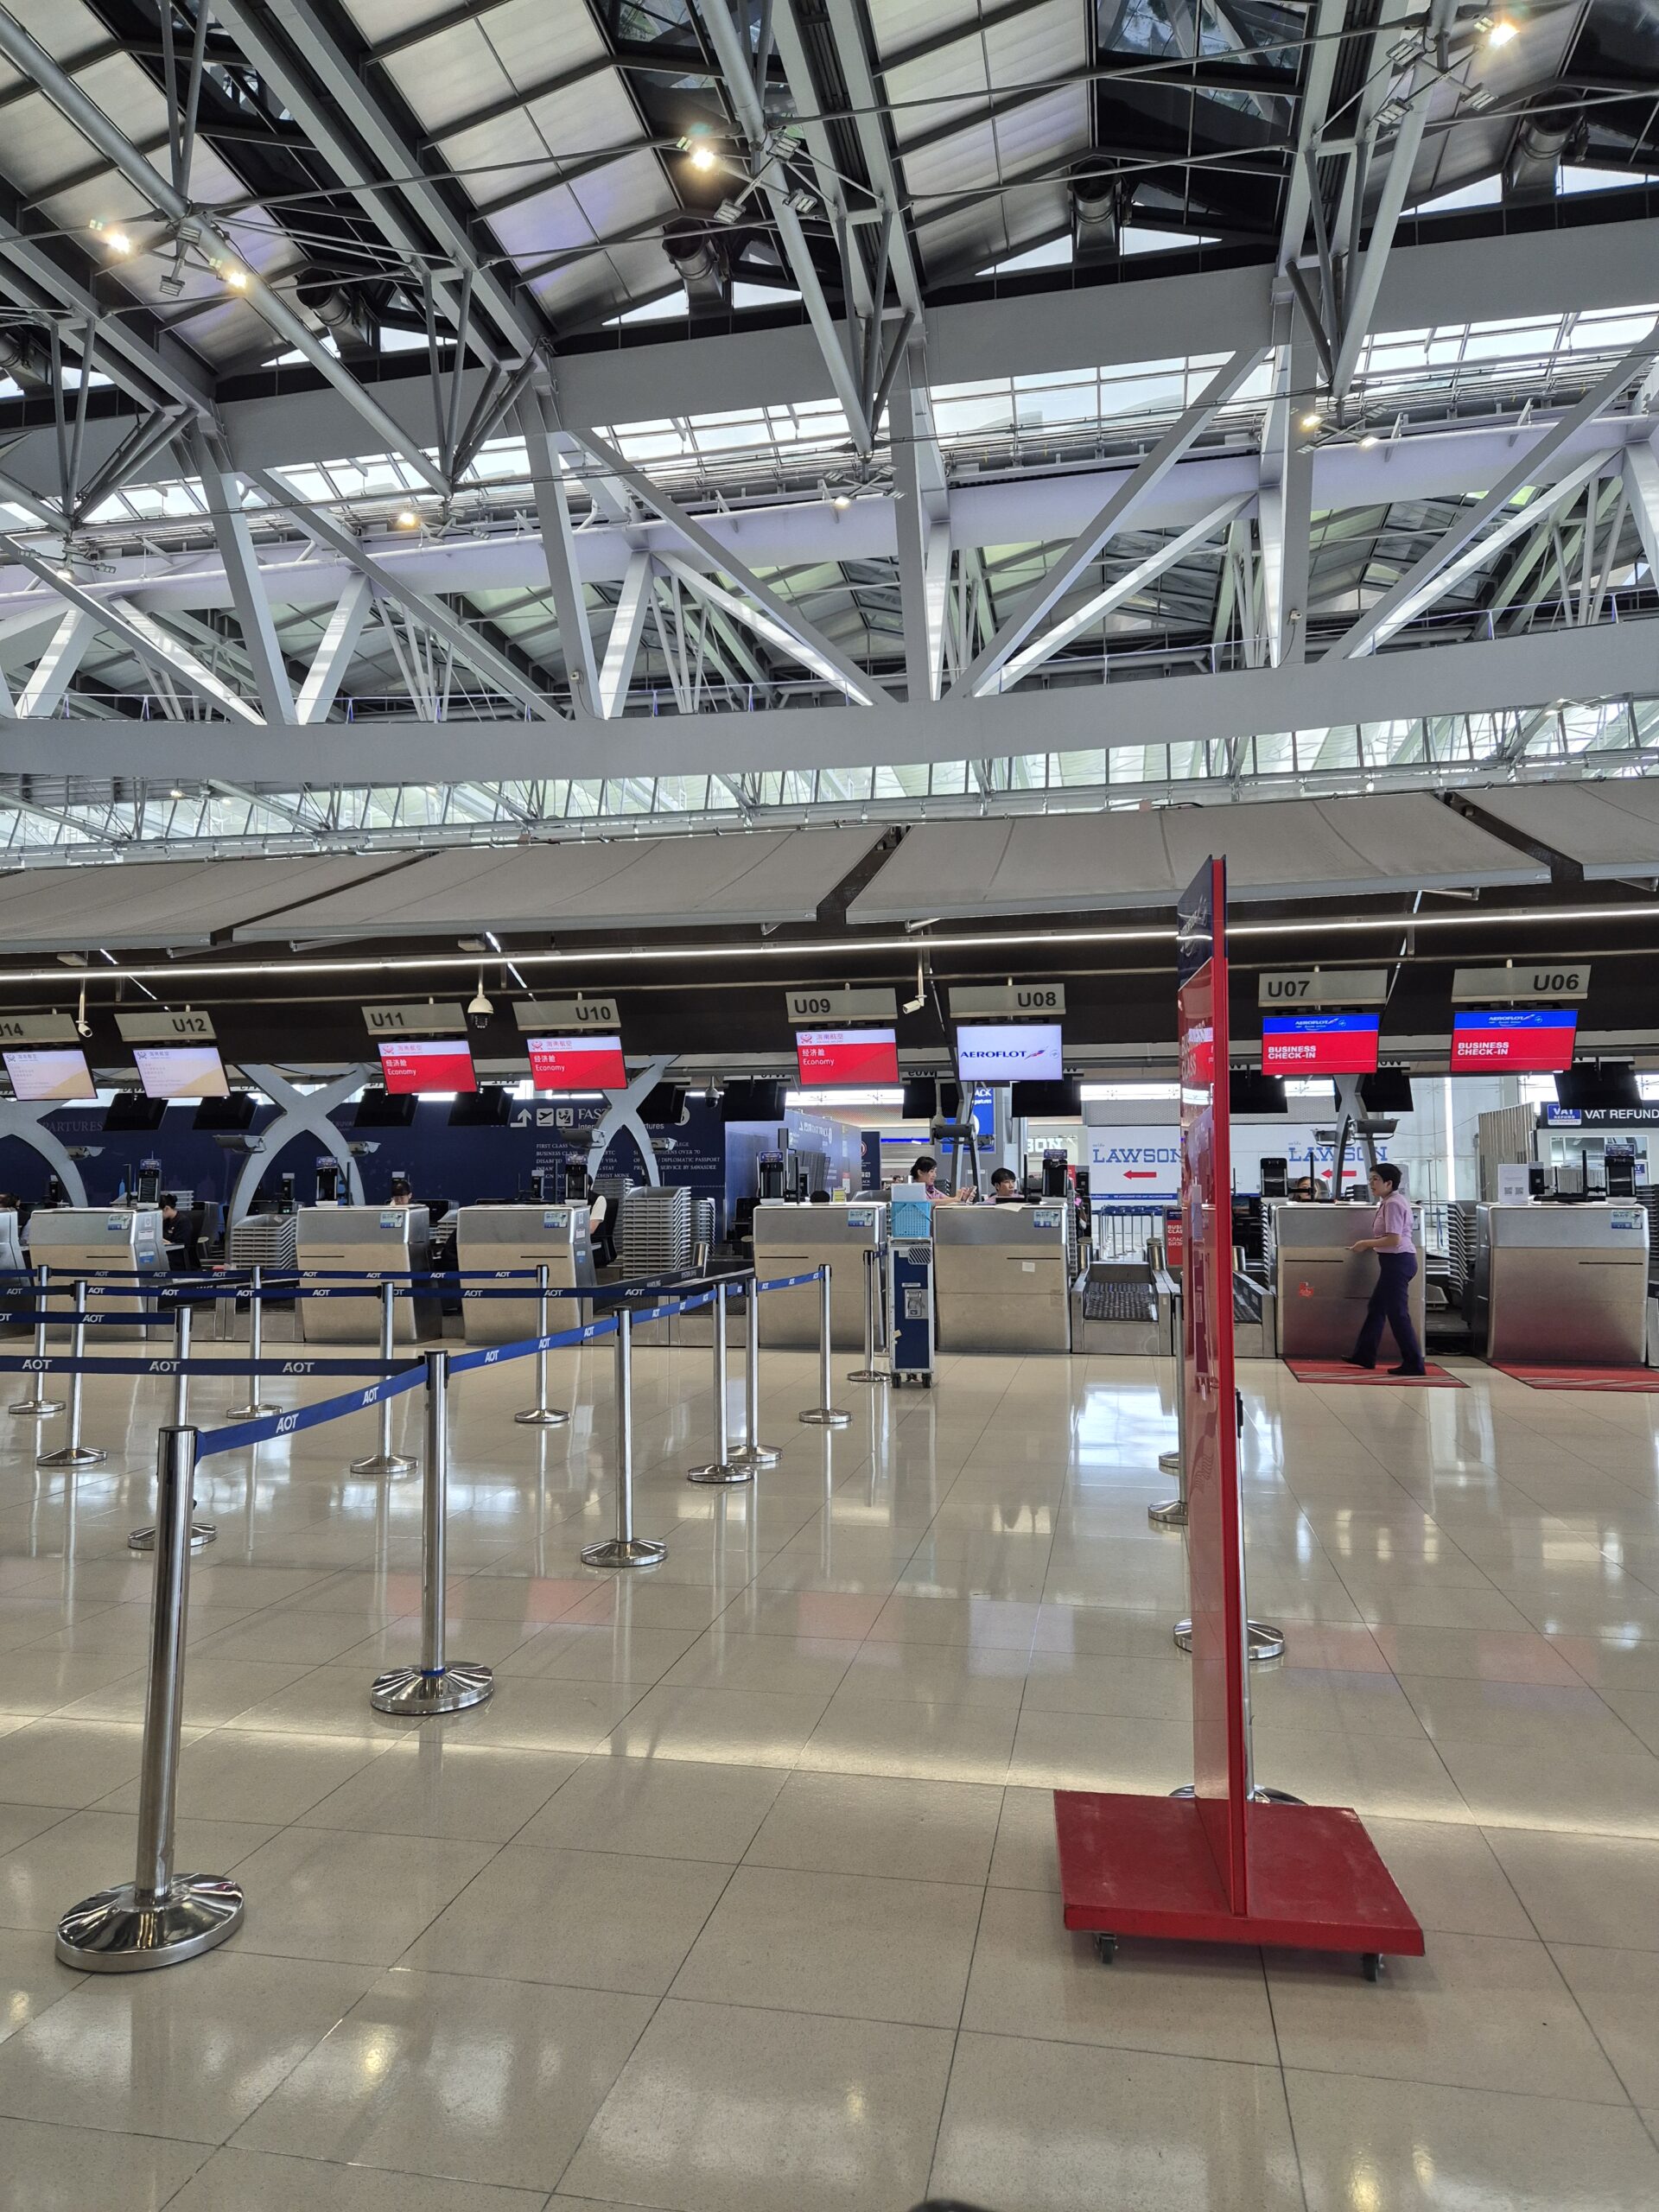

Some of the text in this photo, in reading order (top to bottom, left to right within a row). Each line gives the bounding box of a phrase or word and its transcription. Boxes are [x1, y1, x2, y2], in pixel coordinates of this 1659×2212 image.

[1268, 980, 1310, 997] U07
[1533, 973, 1580, 991] U06
[793, 998, 831, 1014] U09
[1017, 992, 1057, 1007] U08
[370, 1012, 405, 1027] U11
[575, 1006, 612, 1021] U10
[173, 1018, 207, 1033] U12
[960, 1050, 1027, 1058] AEROFLOT
[535, 1064, 565, 1072] Economy
[803, 1058, 835, 1066] Economy
[388, 1068, 416, 1076] Economy
[974, 1089, 992, 1097] ACK
[1585, 1109, 1659, 1119] VAT REFUND
[41, 1122, 104, 1131] PARTURES
[1093, 1148, 1182, 1163] LAWSON
[0, 1313, 105, 1323] OT AOT
[485, 1325, 596, 1363] AOT AOT AOT
[22, 1359, 315, 1373] AOT AOT AOT
[276, 1386, 379, 1434] AOT AOT
